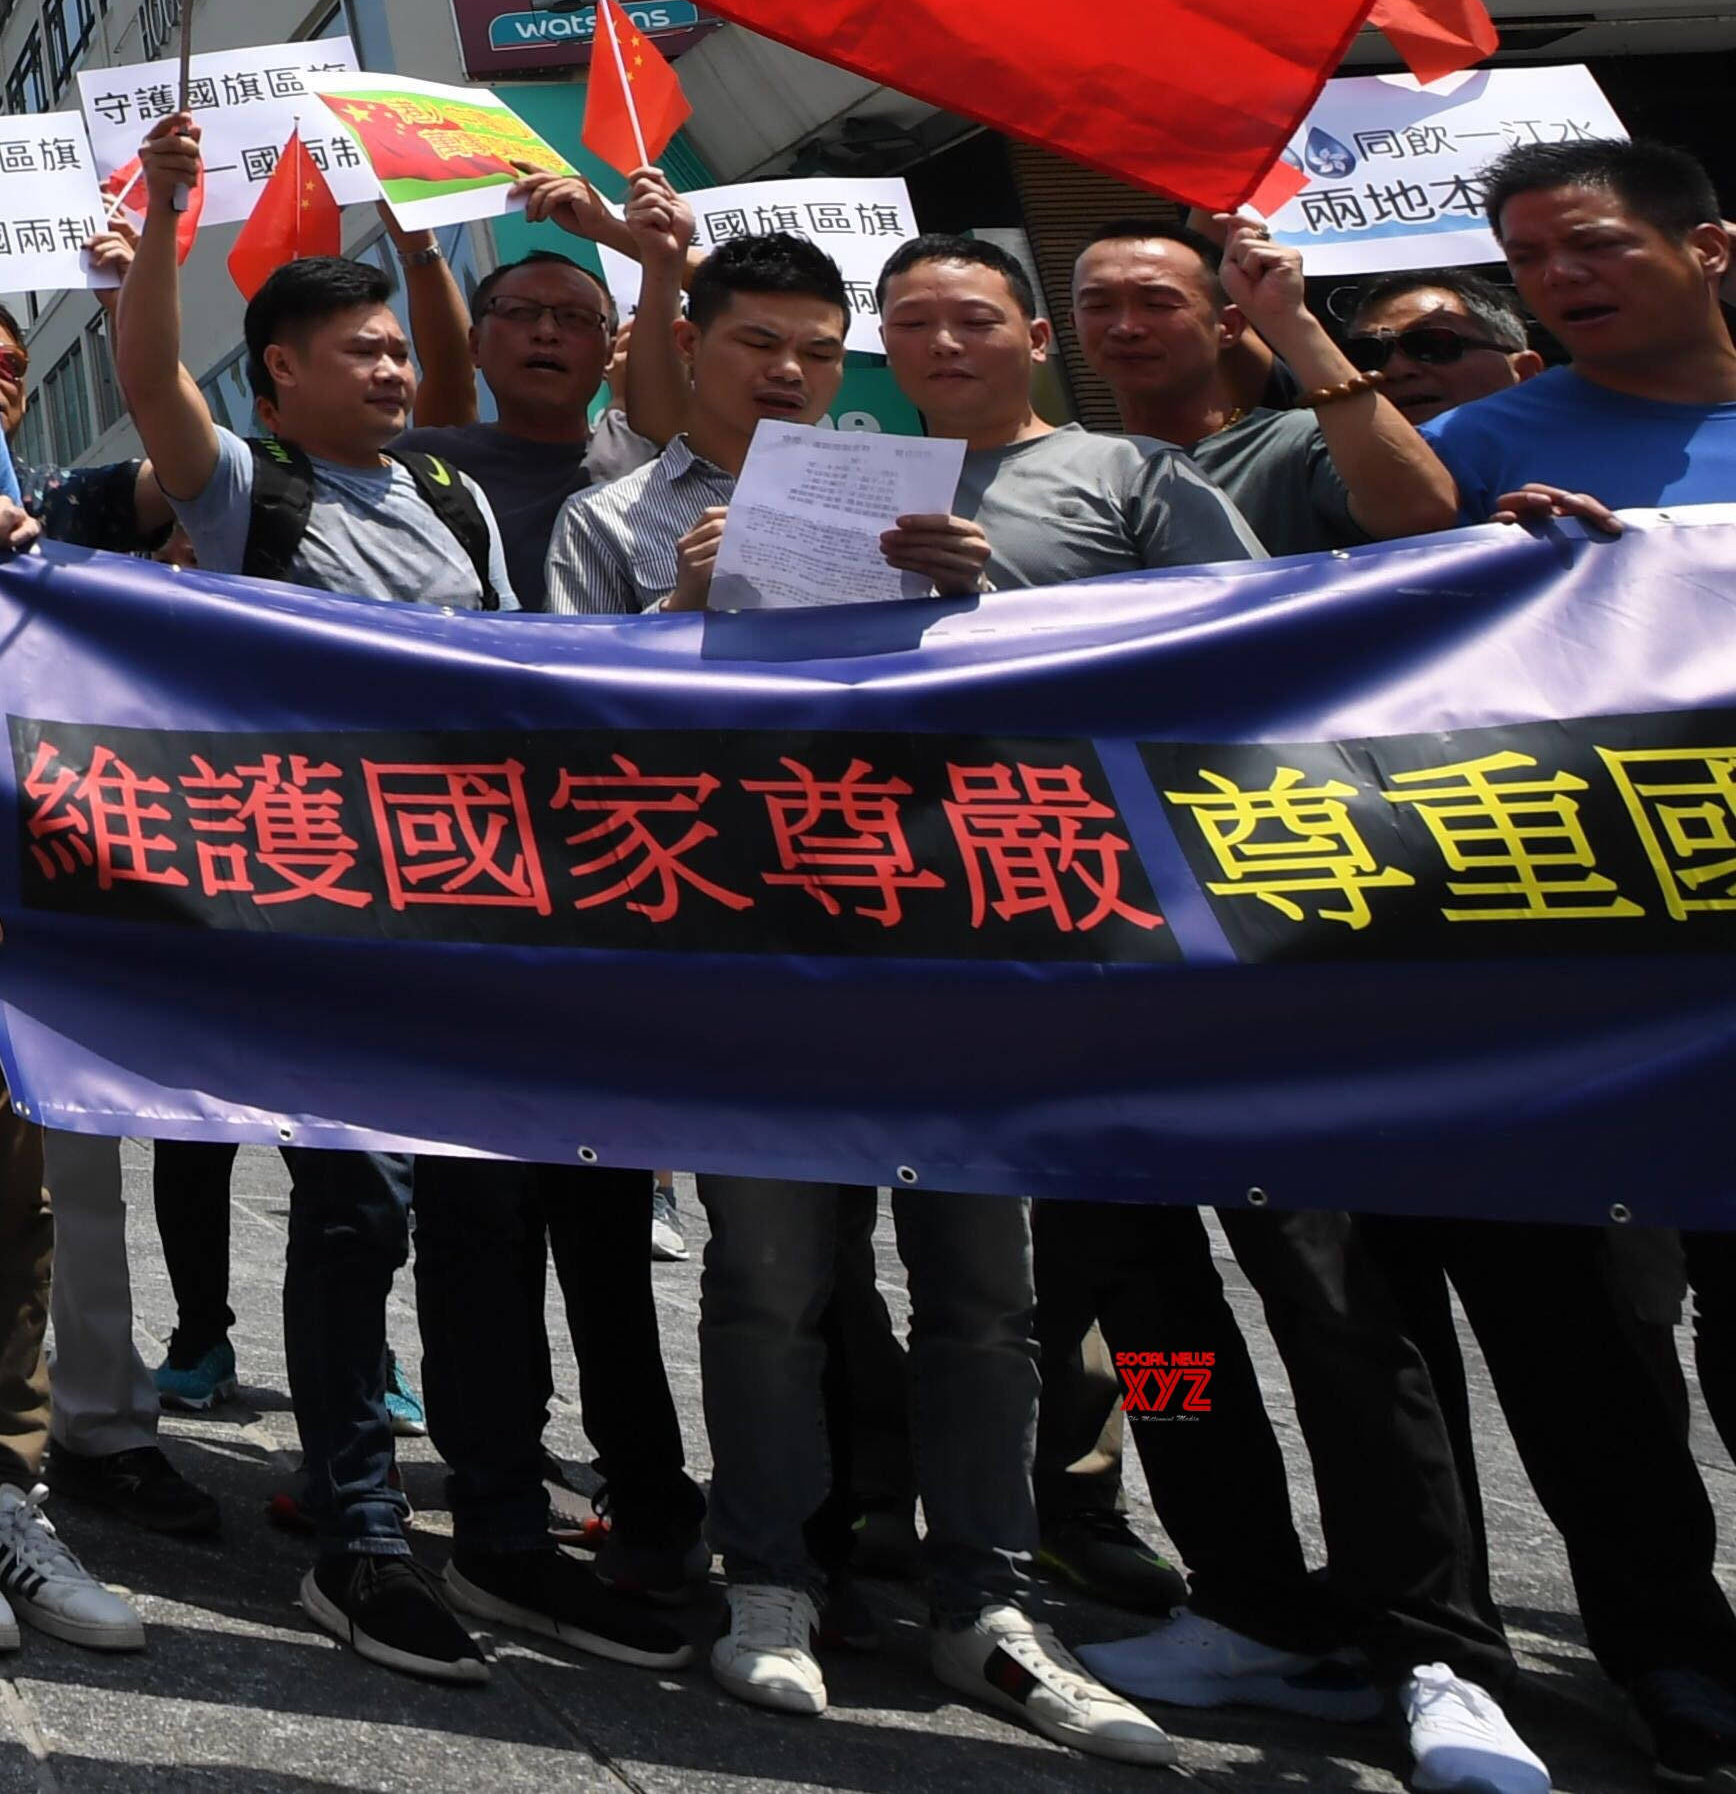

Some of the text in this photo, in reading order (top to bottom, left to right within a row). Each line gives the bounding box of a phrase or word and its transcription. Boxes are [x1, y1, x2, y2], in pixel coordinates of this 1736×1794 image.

[515, 8, 671, 39] watsns
[94, 63, 347, 125] 守護國旗區
[695, 202, 906, 247] 國旗區旗
[24, 742, 1167, 933] 維護國家尊嚴
